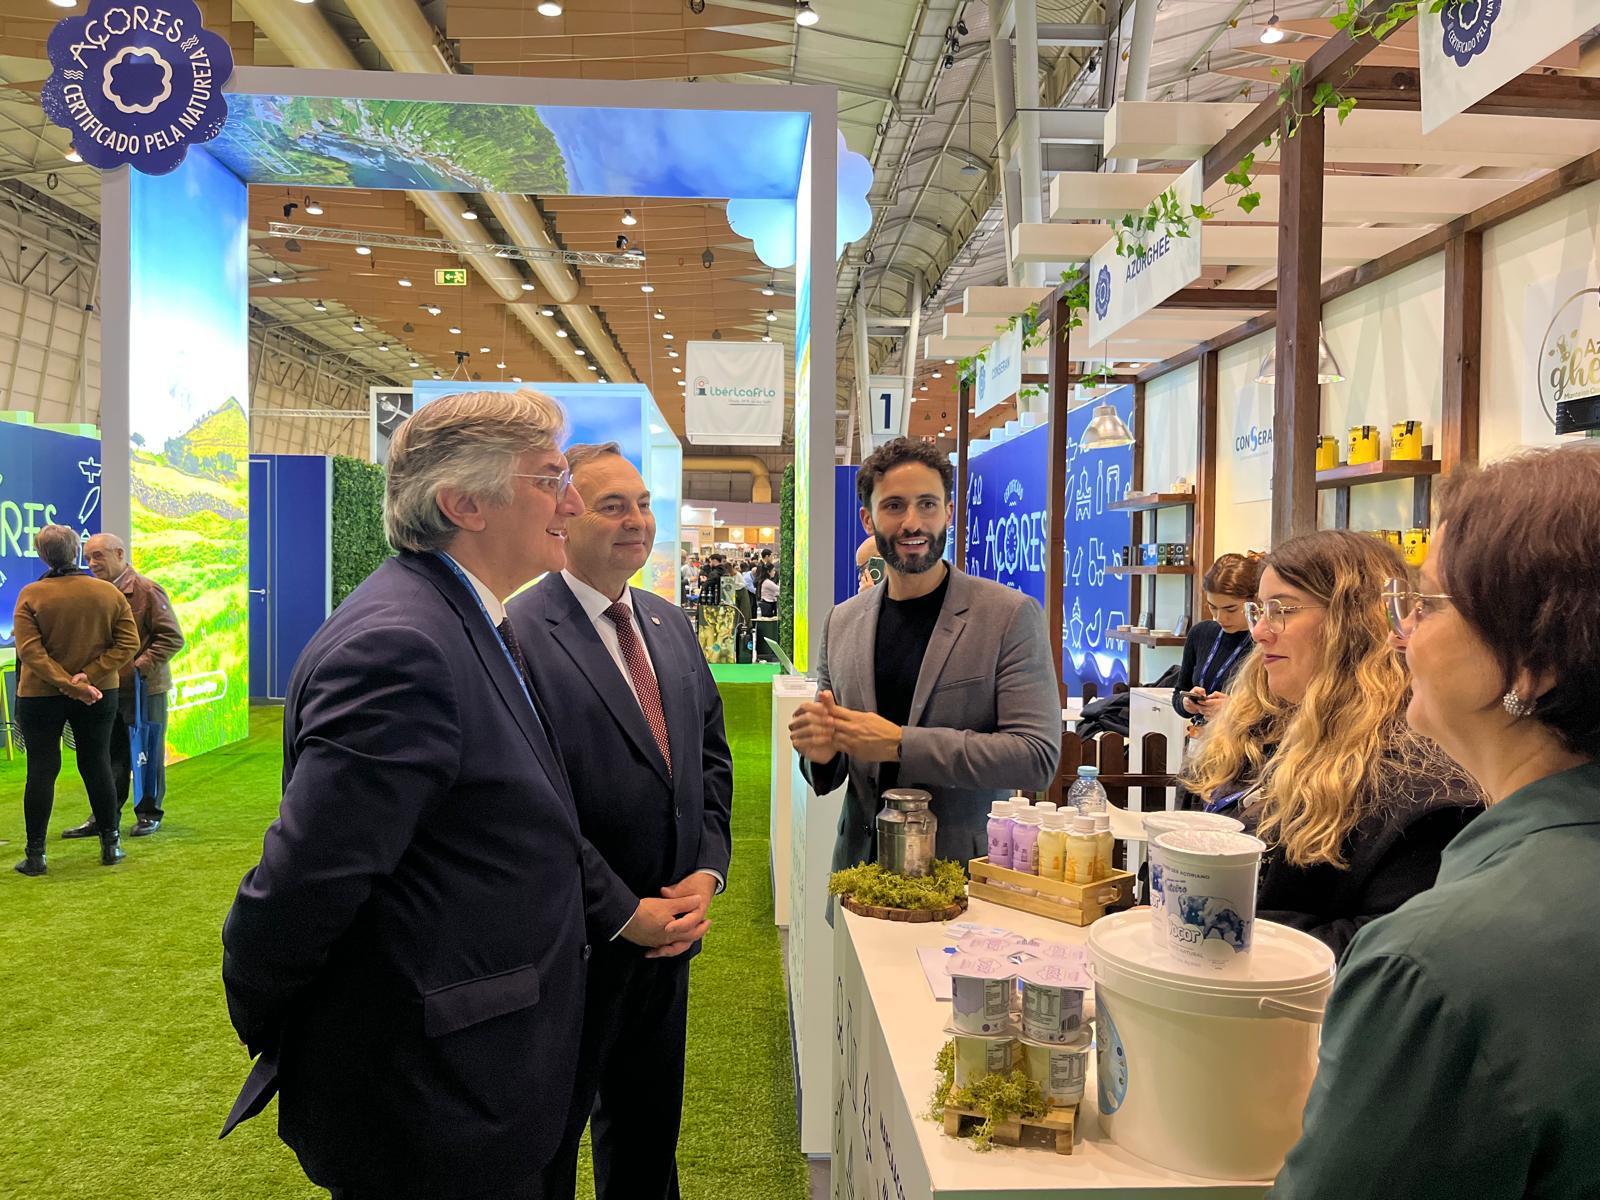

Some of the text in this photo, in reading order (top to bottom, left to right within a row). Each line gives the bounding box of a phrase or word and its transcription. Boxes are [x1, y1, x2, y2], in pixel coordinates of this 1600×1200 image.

[69, 5, 184, 69] AÇORES
[63, 47, 213, 155] CERTIFICADO PELA NATUREZA
[1126, 234, 1170, 283] AZORGHEE
[880, 393, 892, 430] 1
